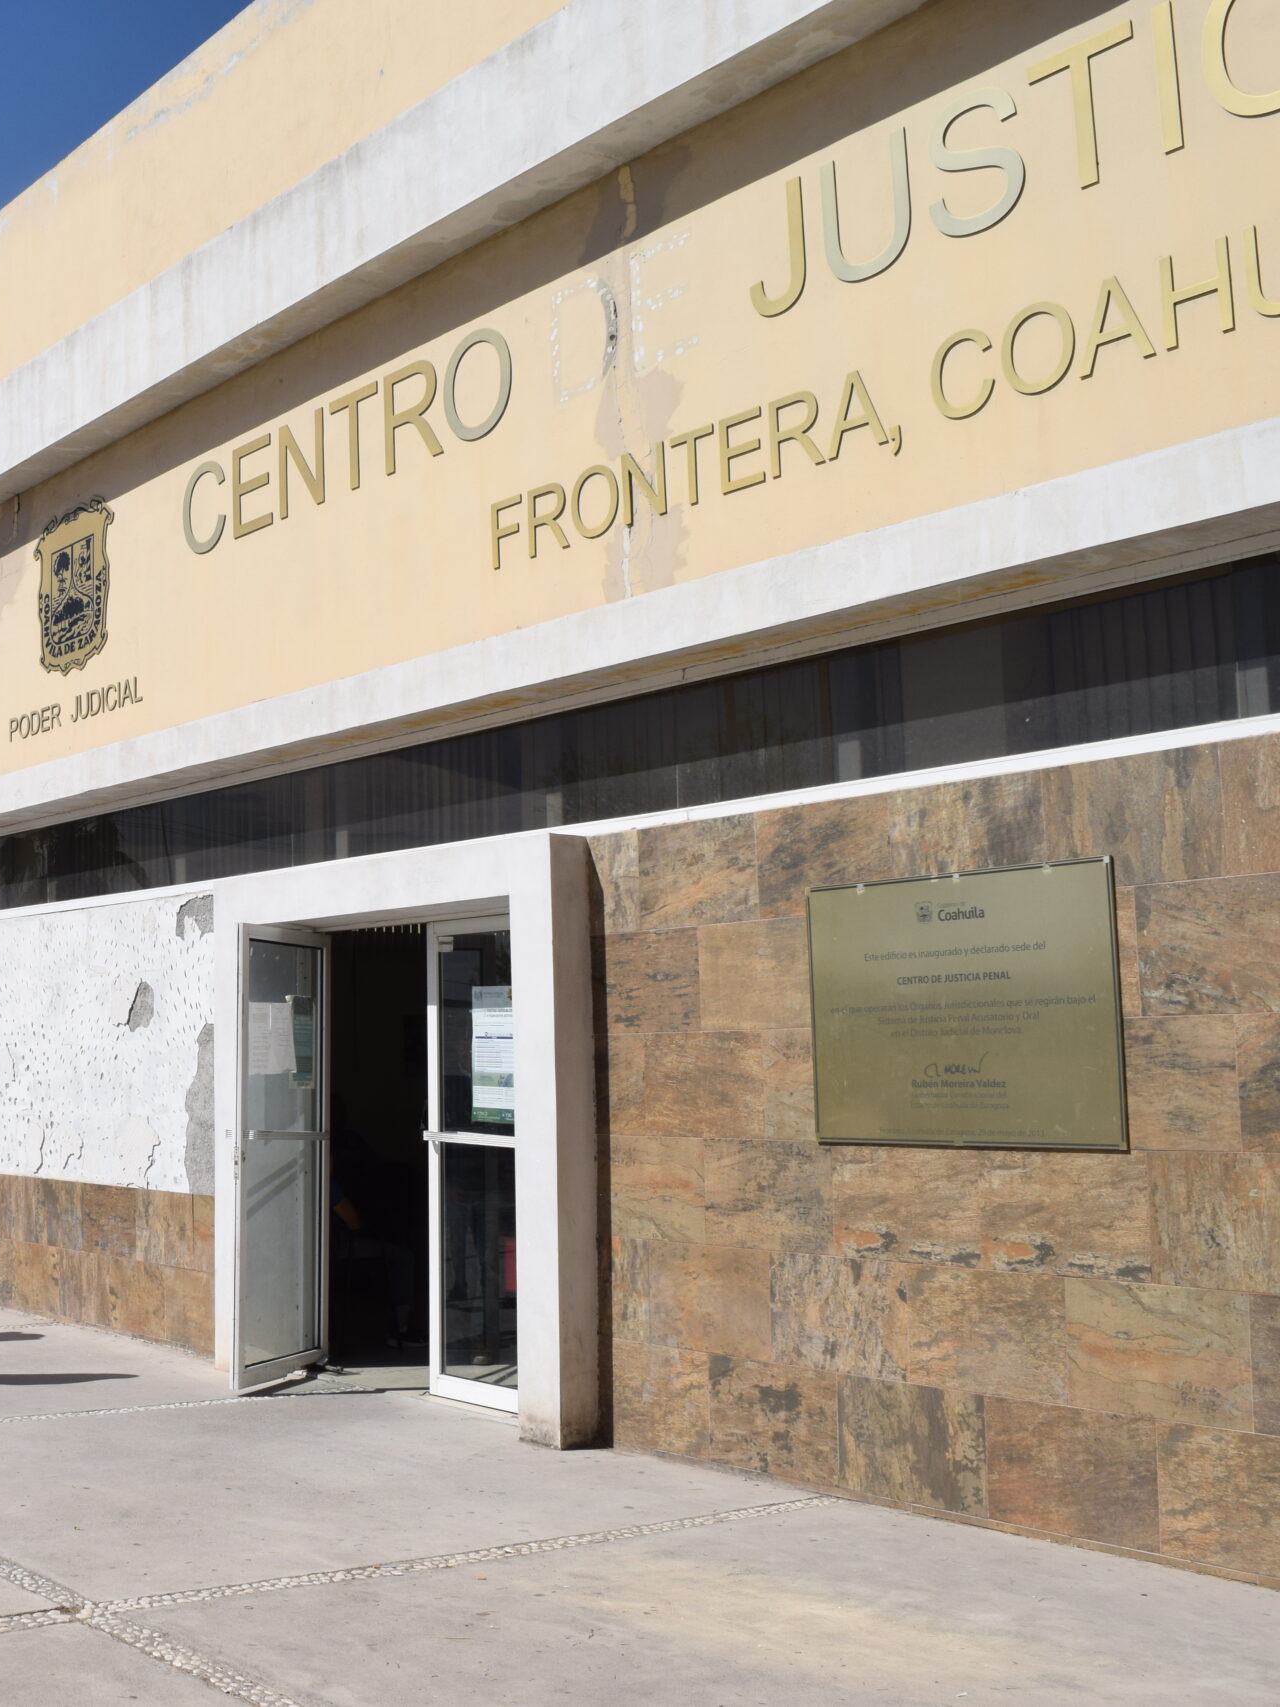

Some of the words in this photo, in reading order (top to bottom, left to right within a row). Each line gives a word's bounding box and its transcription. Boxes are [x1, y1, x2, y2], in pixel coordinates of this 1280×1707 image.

[182, 327, 512, 555] CENTRO
[490, 370, 902, 571] FRONTERA,
[64, 641, 76, 655] DE
[9, 703, 62, 743] PODER
[70, 676, 144, 723] JUDICIAL
[937, 906, 985, 922] Coahuila
[863, 952, 880, 962] Este
[880, 950, 907, 960] edificio
[908, 952, 917, 960] es
[918, 947, 963, 959] inaugurado
[963, 949, 969, 957] y
[970, 943, 1010, 955] declarado
[1011, 942, 1031, 952] sede
[1032, 940, 1047, 950] del
[896, 975, 930, 985] CENTRO
[931, 974, 943, 983] DE
[944, 971, 981, 983] JUSTICIA
[982, 970, 1012, 981] PENAL
[1022, 1010, 1040, 1021] Oral
[940, 1078, 975, 1088] Moreira
[976, 1078, 1008, 1088] Valdez
